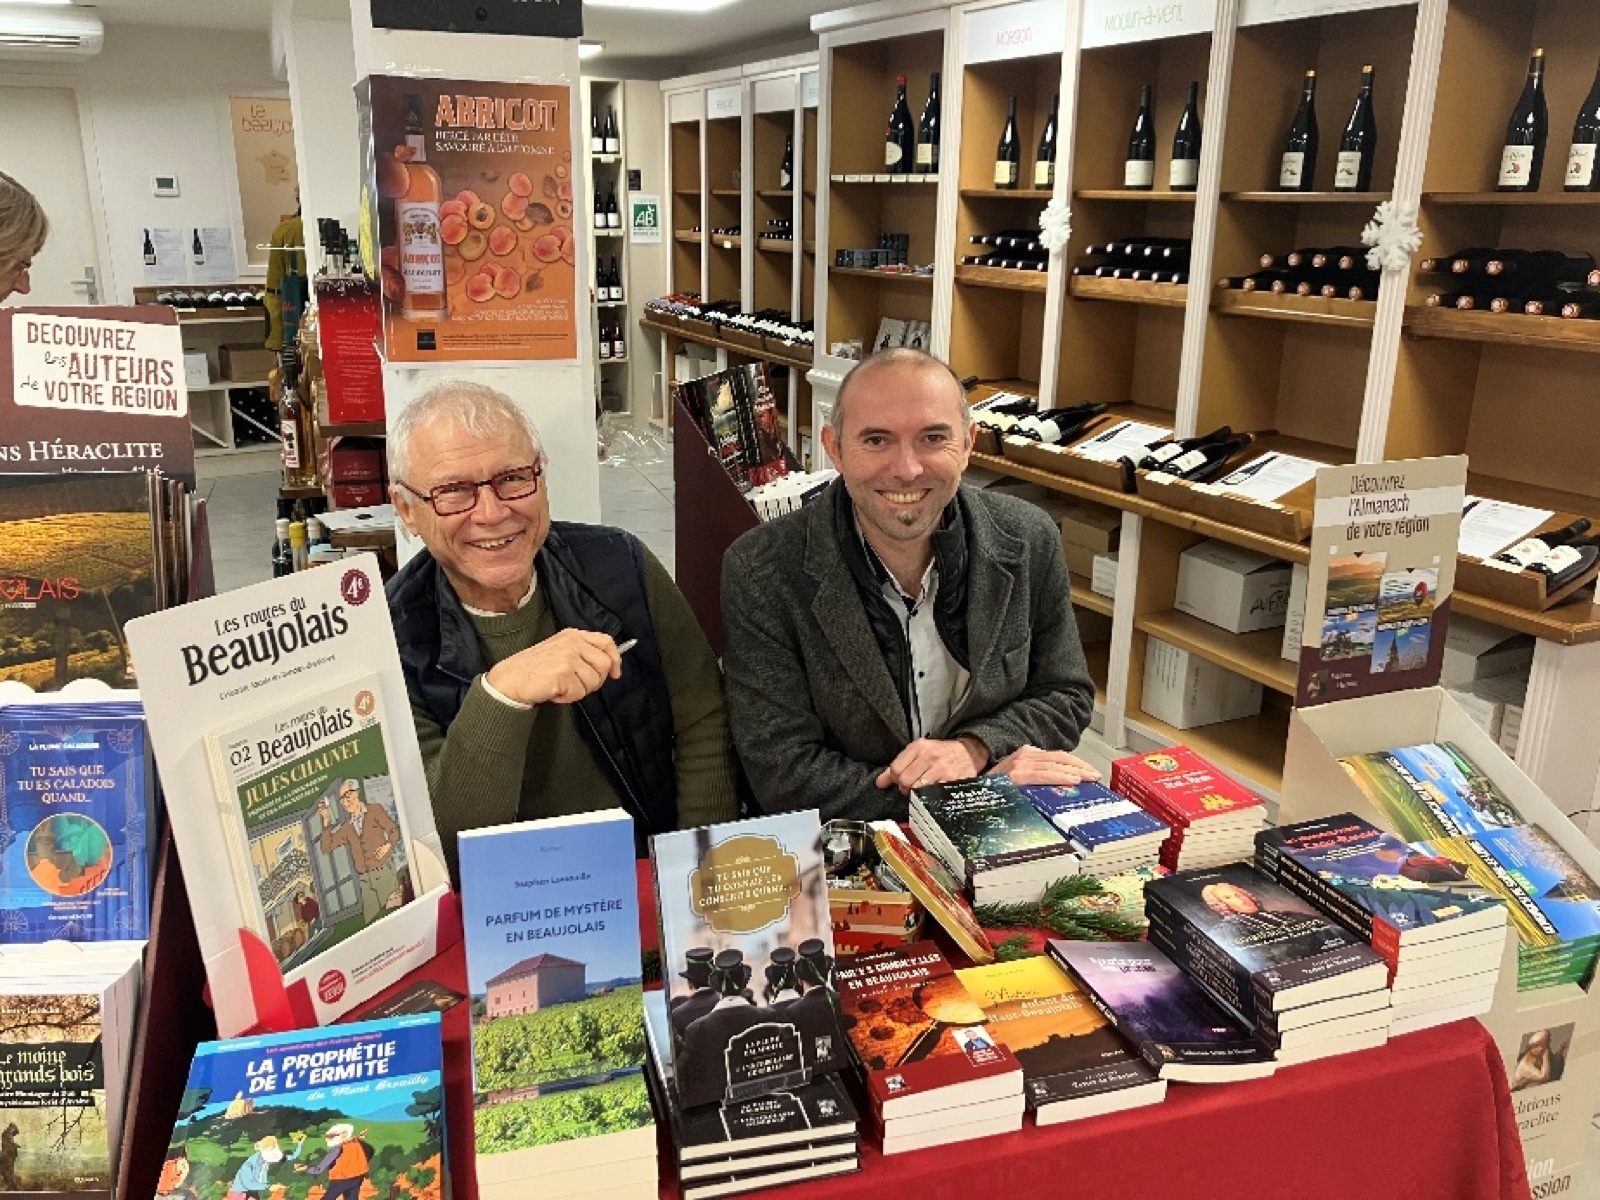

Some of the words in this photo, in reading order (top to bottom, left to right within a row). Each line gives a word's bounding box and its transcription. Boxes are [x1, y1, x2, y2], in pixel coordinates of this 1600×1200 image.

[435, 94, 559, 132] ABRICOT
[27, 321, 136, 351] DECOUVREZ
[68, 352, 174, 386] AUTEURS
[44, 380, 105, 405] VOTRE
[112, 385, 178, 411] REGION
[28, 437, 164, 461] HÉRACLITE
[1350, 474, 1406, 495] Découvrez
[1346, 521, 1360, 541] de
[1363, 519, 1392, 539] votre
[1394, 515, 1430, 539] région
[214, 615, 240, 636] Les
[243, 602, 287, 629] routes
[289, 595, 307, 612] du
[180, 602, 349, 686] Beaujolais
[257, 707, 354, 766] Beaujolais
[17, 780, 34, 791] TU
[36, 779, 51, 791] ES
[53, 778, 116, 790] CALADOIS
[29, 766, 46, 777] TU
[49, 766, 77, 777] SAIS
[79, 765, 105, 778] QUE
[244, 771, 291, 810] JULES
[291, 739, 361, 783] CHAUVET
[486, 908, 541, 928] PARFUM
[544, 906, 562, 920] DE
[564, 898, 623, 917] MYSTÈRE
[506, 930, 524, 943] EN
[527, 920, 606, 941] BEAUJOLAIS
[17, 1046, 67, 1066] moine
[246, 1058, 274, 1077] LA
[282, 1040, 396, 1070] PROPHÉTIE
[59, 1061, 96, 1088] bois
[249, 1074, 277, 1094] DE
